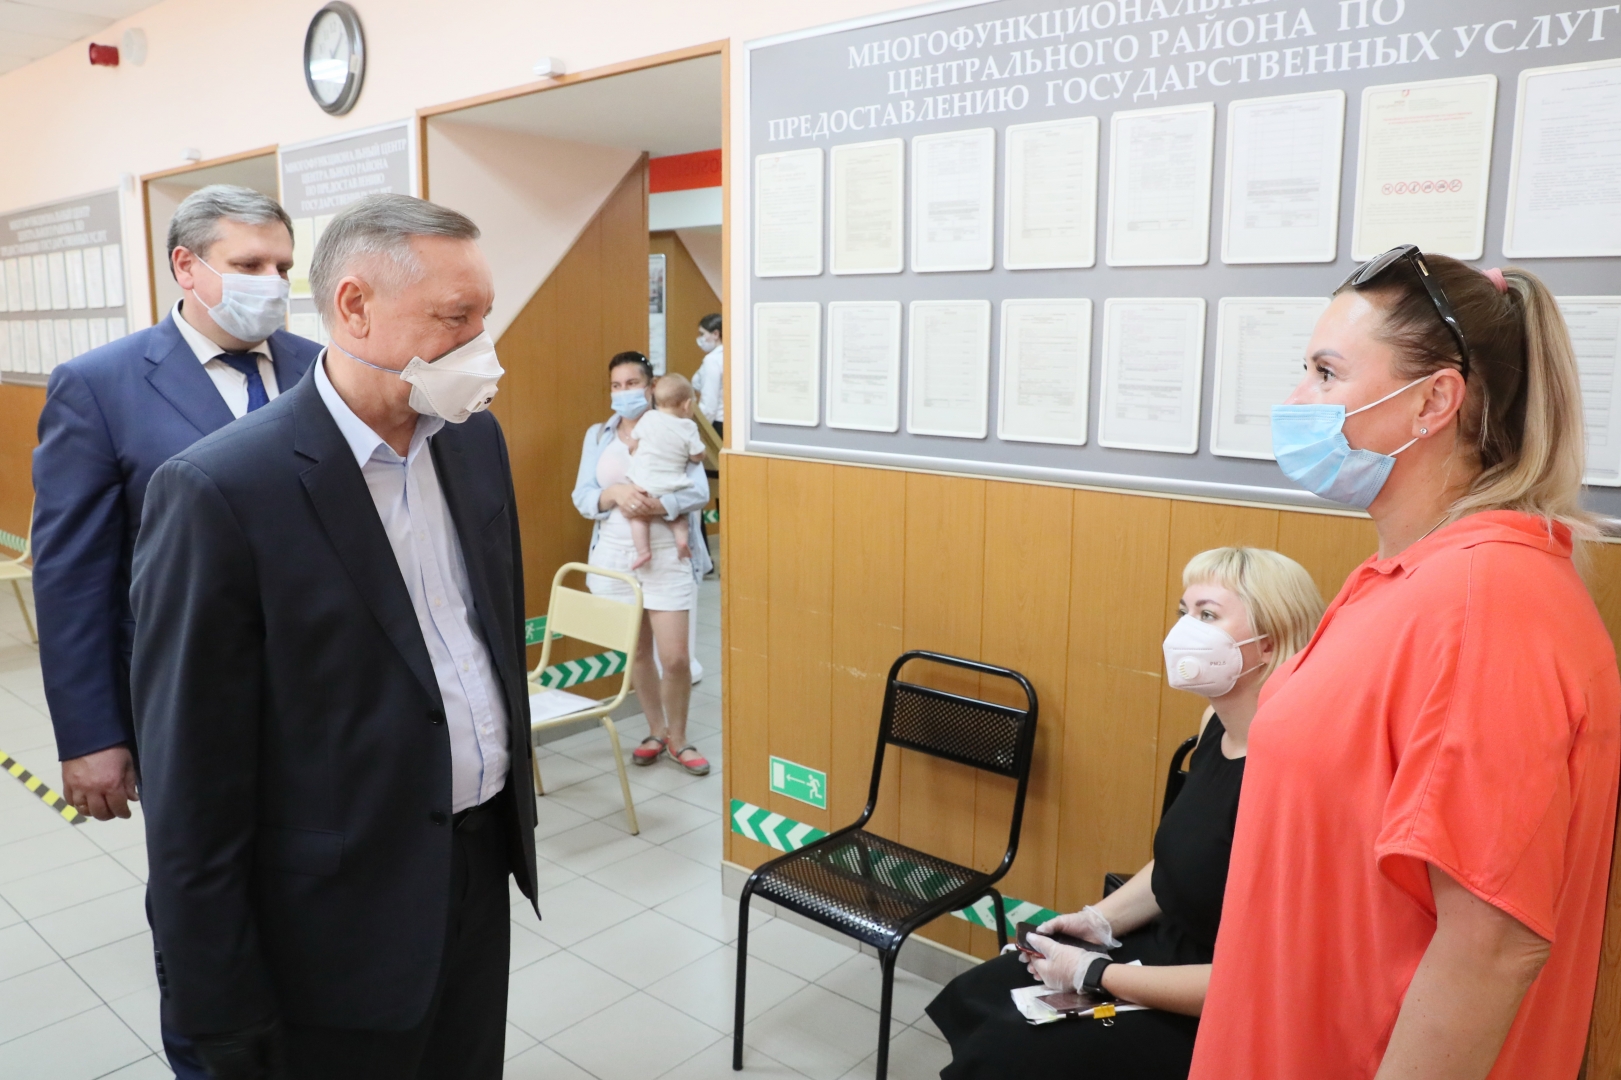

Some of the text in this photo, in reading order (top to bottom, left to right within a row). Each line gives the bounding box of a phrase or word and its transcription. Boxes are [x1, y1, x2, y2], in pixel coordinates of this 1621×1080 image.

[768, 4, 1620, 142] ПРЕДОСТАВЛЕНИЮ ГОСУДАРСТВЕННЫХ УСЛУГ
[847, 0, 1279, 69] МНОГОФУНКЦИОНАЛЬ
[887, 0, 1407, 96] ЦЕНТРАЛЬНОГО РАЙОНА ПО
